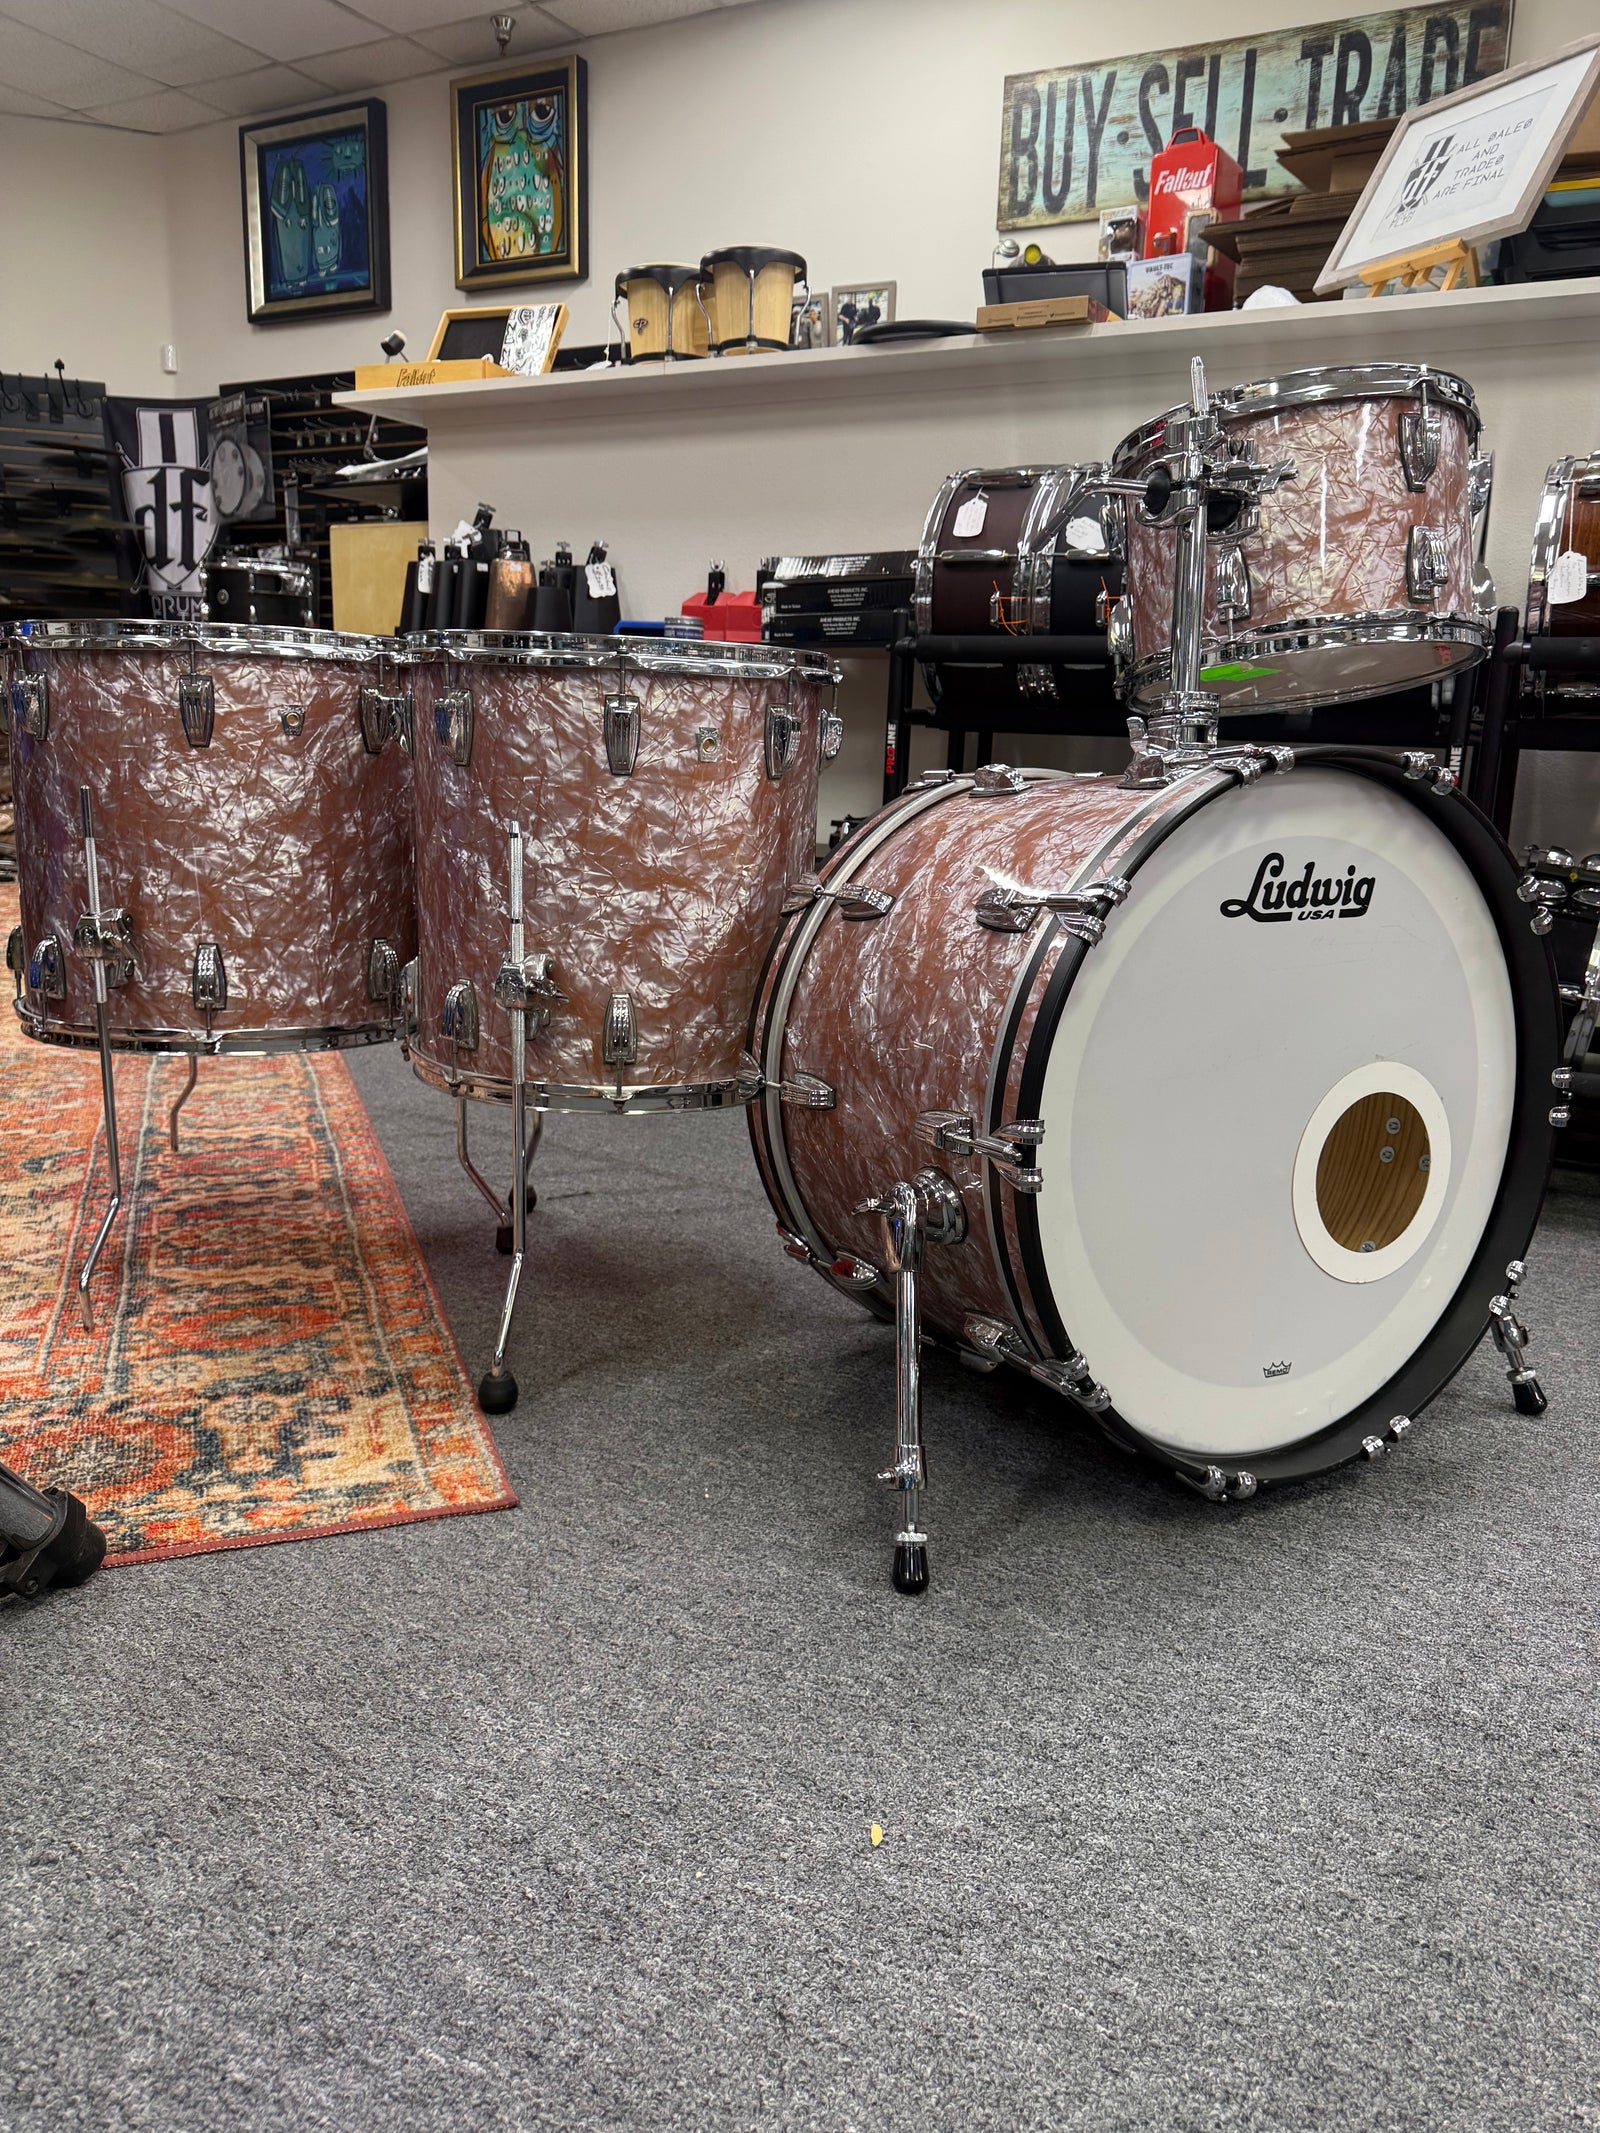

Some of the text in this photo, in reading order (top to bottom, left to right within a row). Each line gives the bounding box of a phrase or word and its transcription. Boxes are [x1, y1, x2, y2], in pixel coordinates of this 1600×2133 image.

[1009, 70, 1117, 219] BUY
[1300, 5, 1505, 130] TRADE
[1457, 138, 1481, 154] ALL
[1472, 143, 1500, 161] AND
[1154, 162, 1214, 196] Fallout
[1432, 168, 1504, 200] ARE FINAL
[886, 722, 897, 774] PROLINE
[1220, 852, 1376, 923] Ludwig
[1298, 910, 1335, 920] USA
